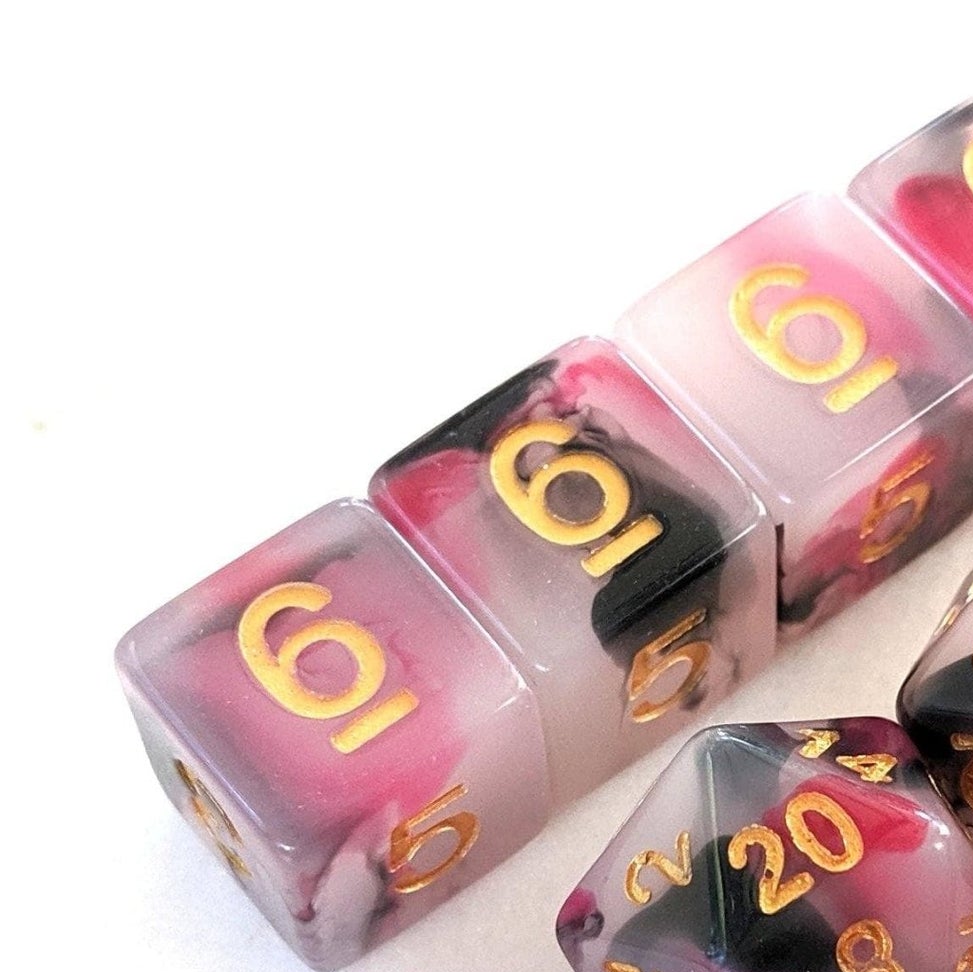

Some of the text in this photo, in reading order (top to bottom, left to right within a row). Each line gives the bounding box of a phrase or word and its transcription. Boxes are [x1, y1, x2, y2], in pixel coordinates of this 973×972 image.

[729, 265, 898, 413] 6
[490, 419, 665, 577] 6
[859, 455, 932, 563] 5
[237, 581, 419, 754] 6
[628, 608, 713, 724] 5
[388, 784, 479, 893] 5
[625, 831, 692, 904] 2
[727, 791, 864, 915] 20
